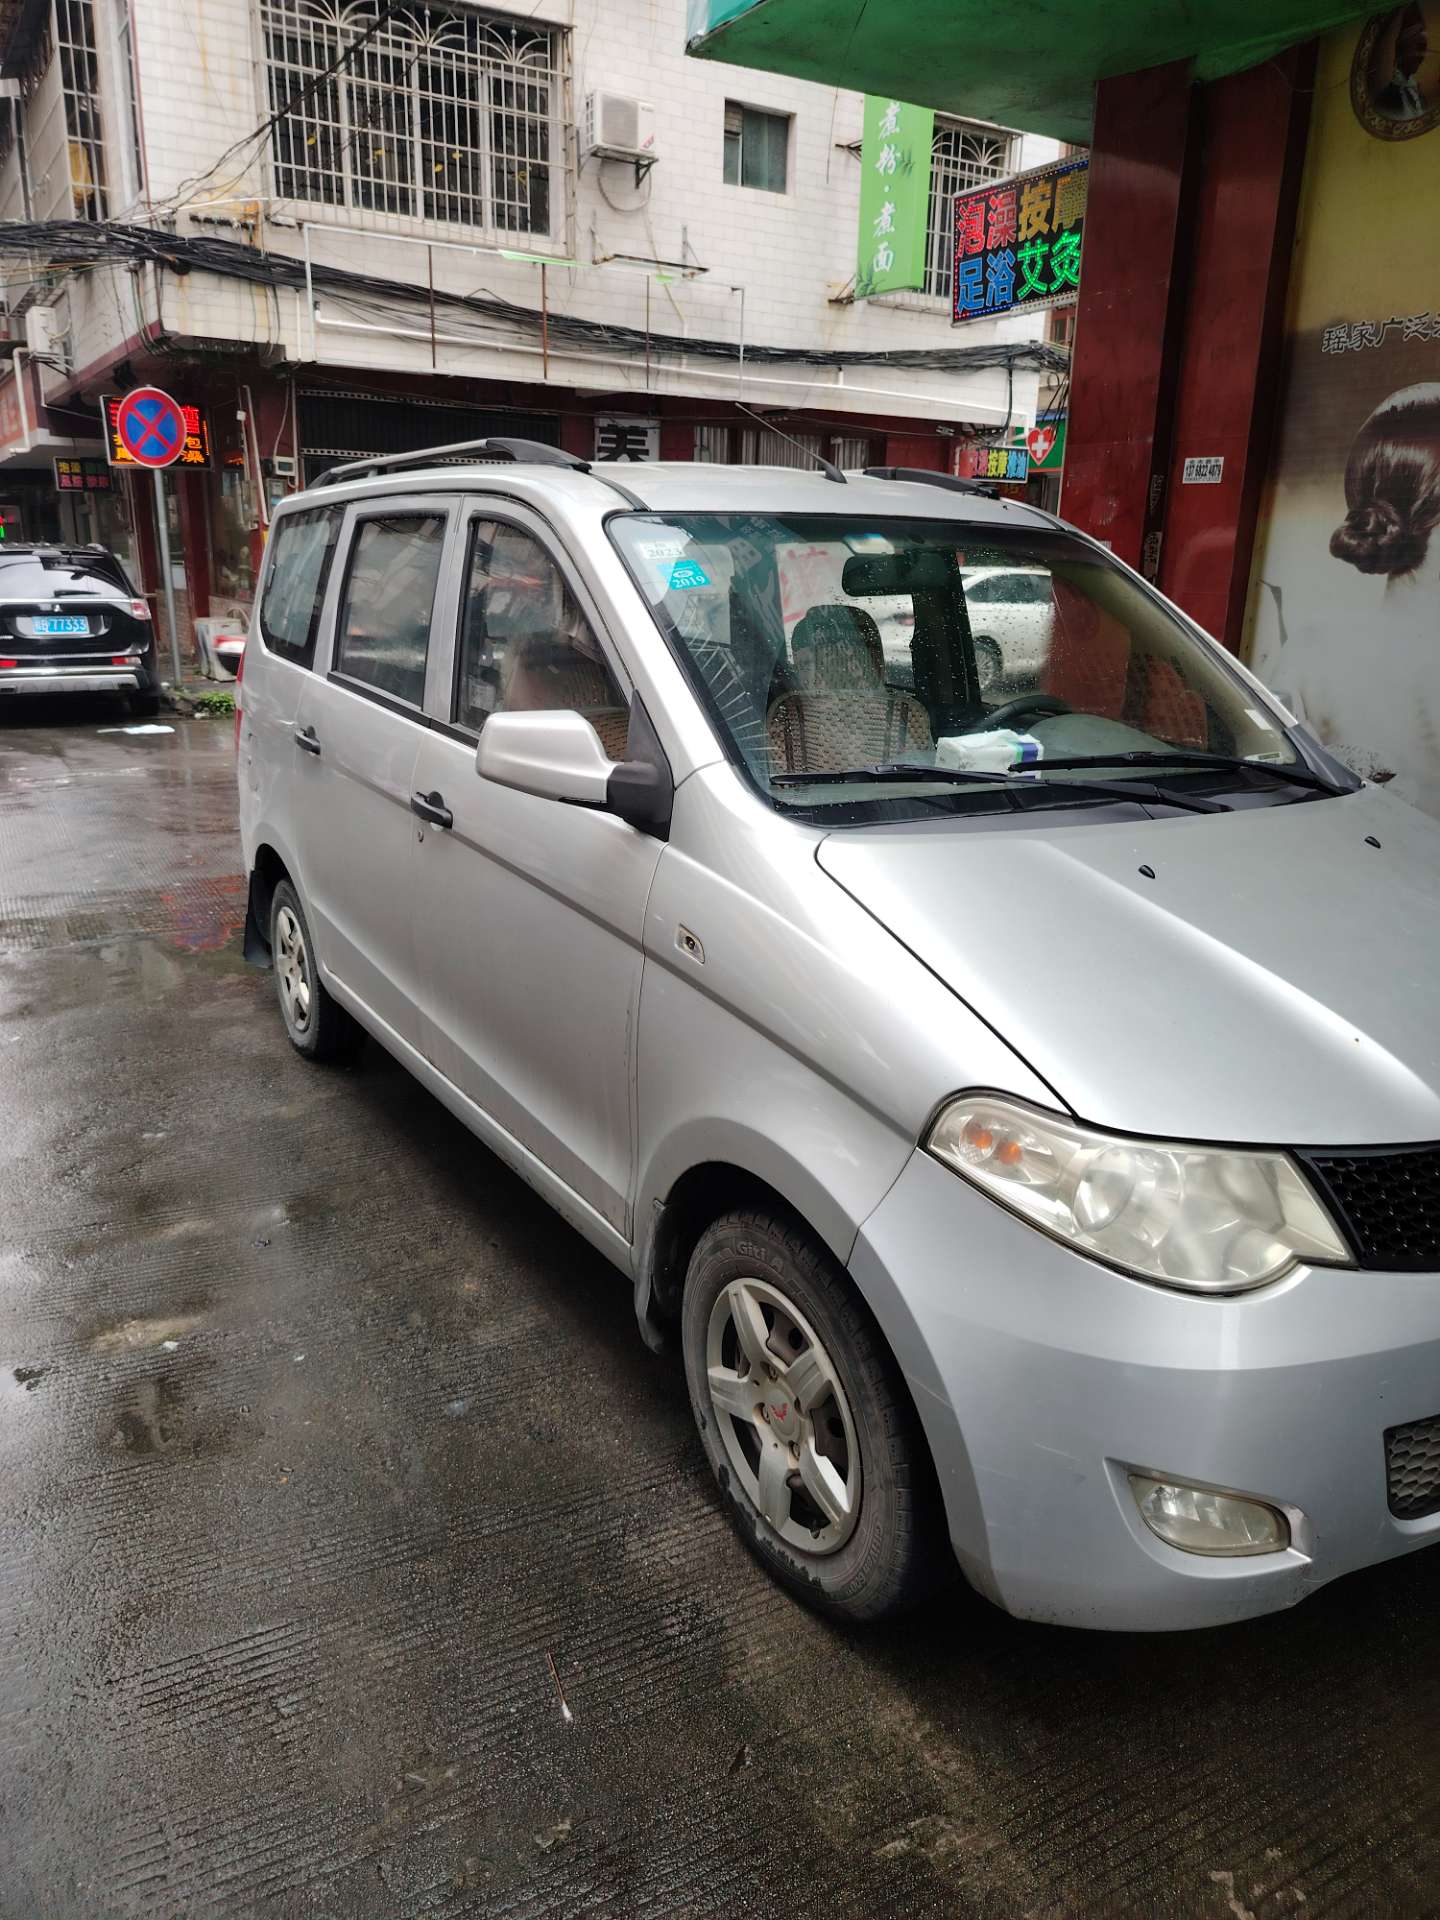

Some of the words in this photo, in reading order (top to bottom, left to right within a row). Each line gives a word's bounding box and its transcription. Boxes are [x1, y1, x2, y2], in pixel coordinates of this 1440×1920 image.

[957, 230, 1082, 313] 足浴艾灸
[672, 575, 706, 588] 2019
